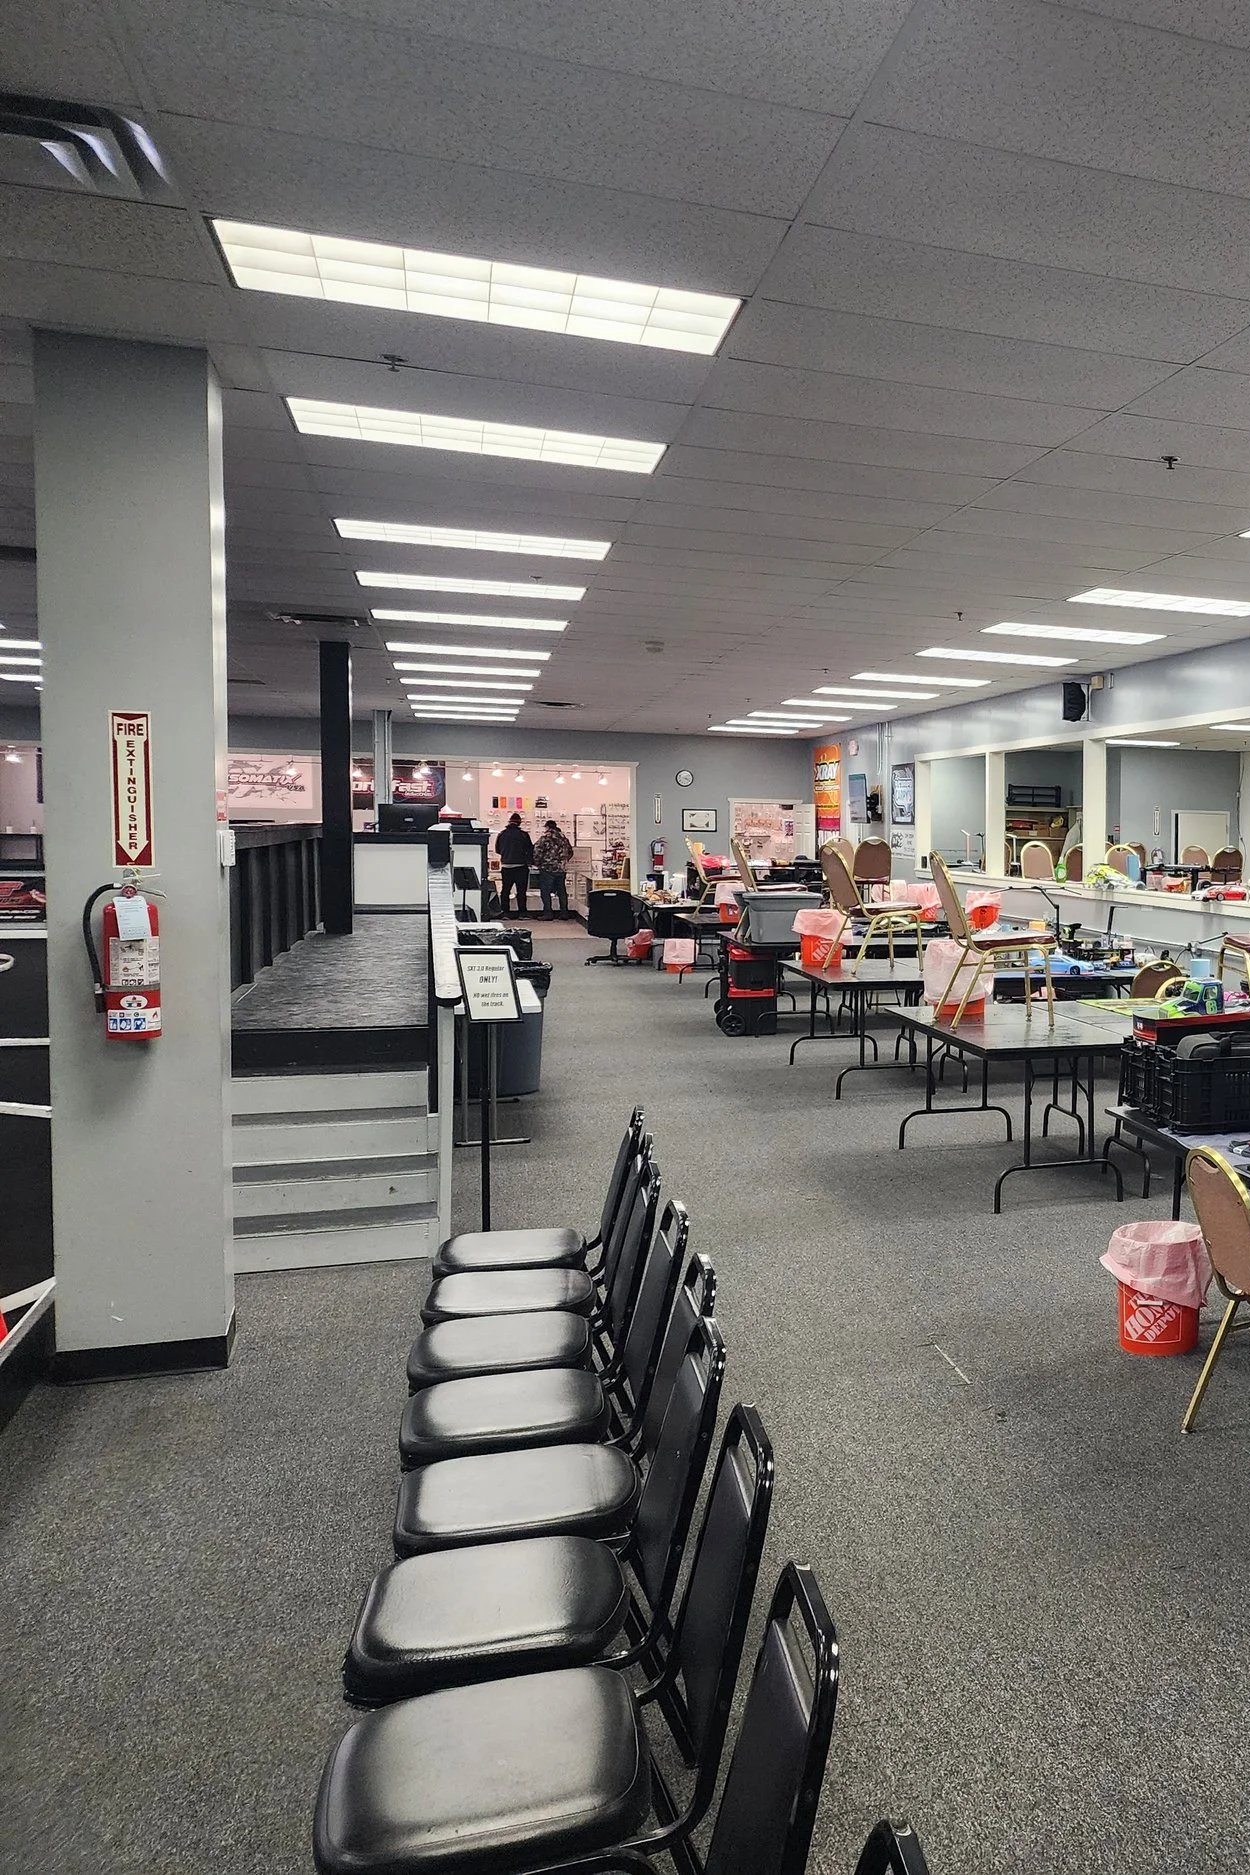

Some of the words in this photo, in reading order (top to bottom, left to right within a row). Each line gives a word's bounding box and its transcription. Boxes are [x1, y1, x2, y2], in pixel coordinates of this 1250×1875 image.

[116, 723, 144, 736] FIRE
[228, 774, 302, 785] SOMATIX
[815, 762, 840, 781] XRAY
[126, 740, 138, 849] EXTINGUISHER
[479, 975, 498, 983] ONLY!
[1124, 1304, 1172, 1340] HOM
